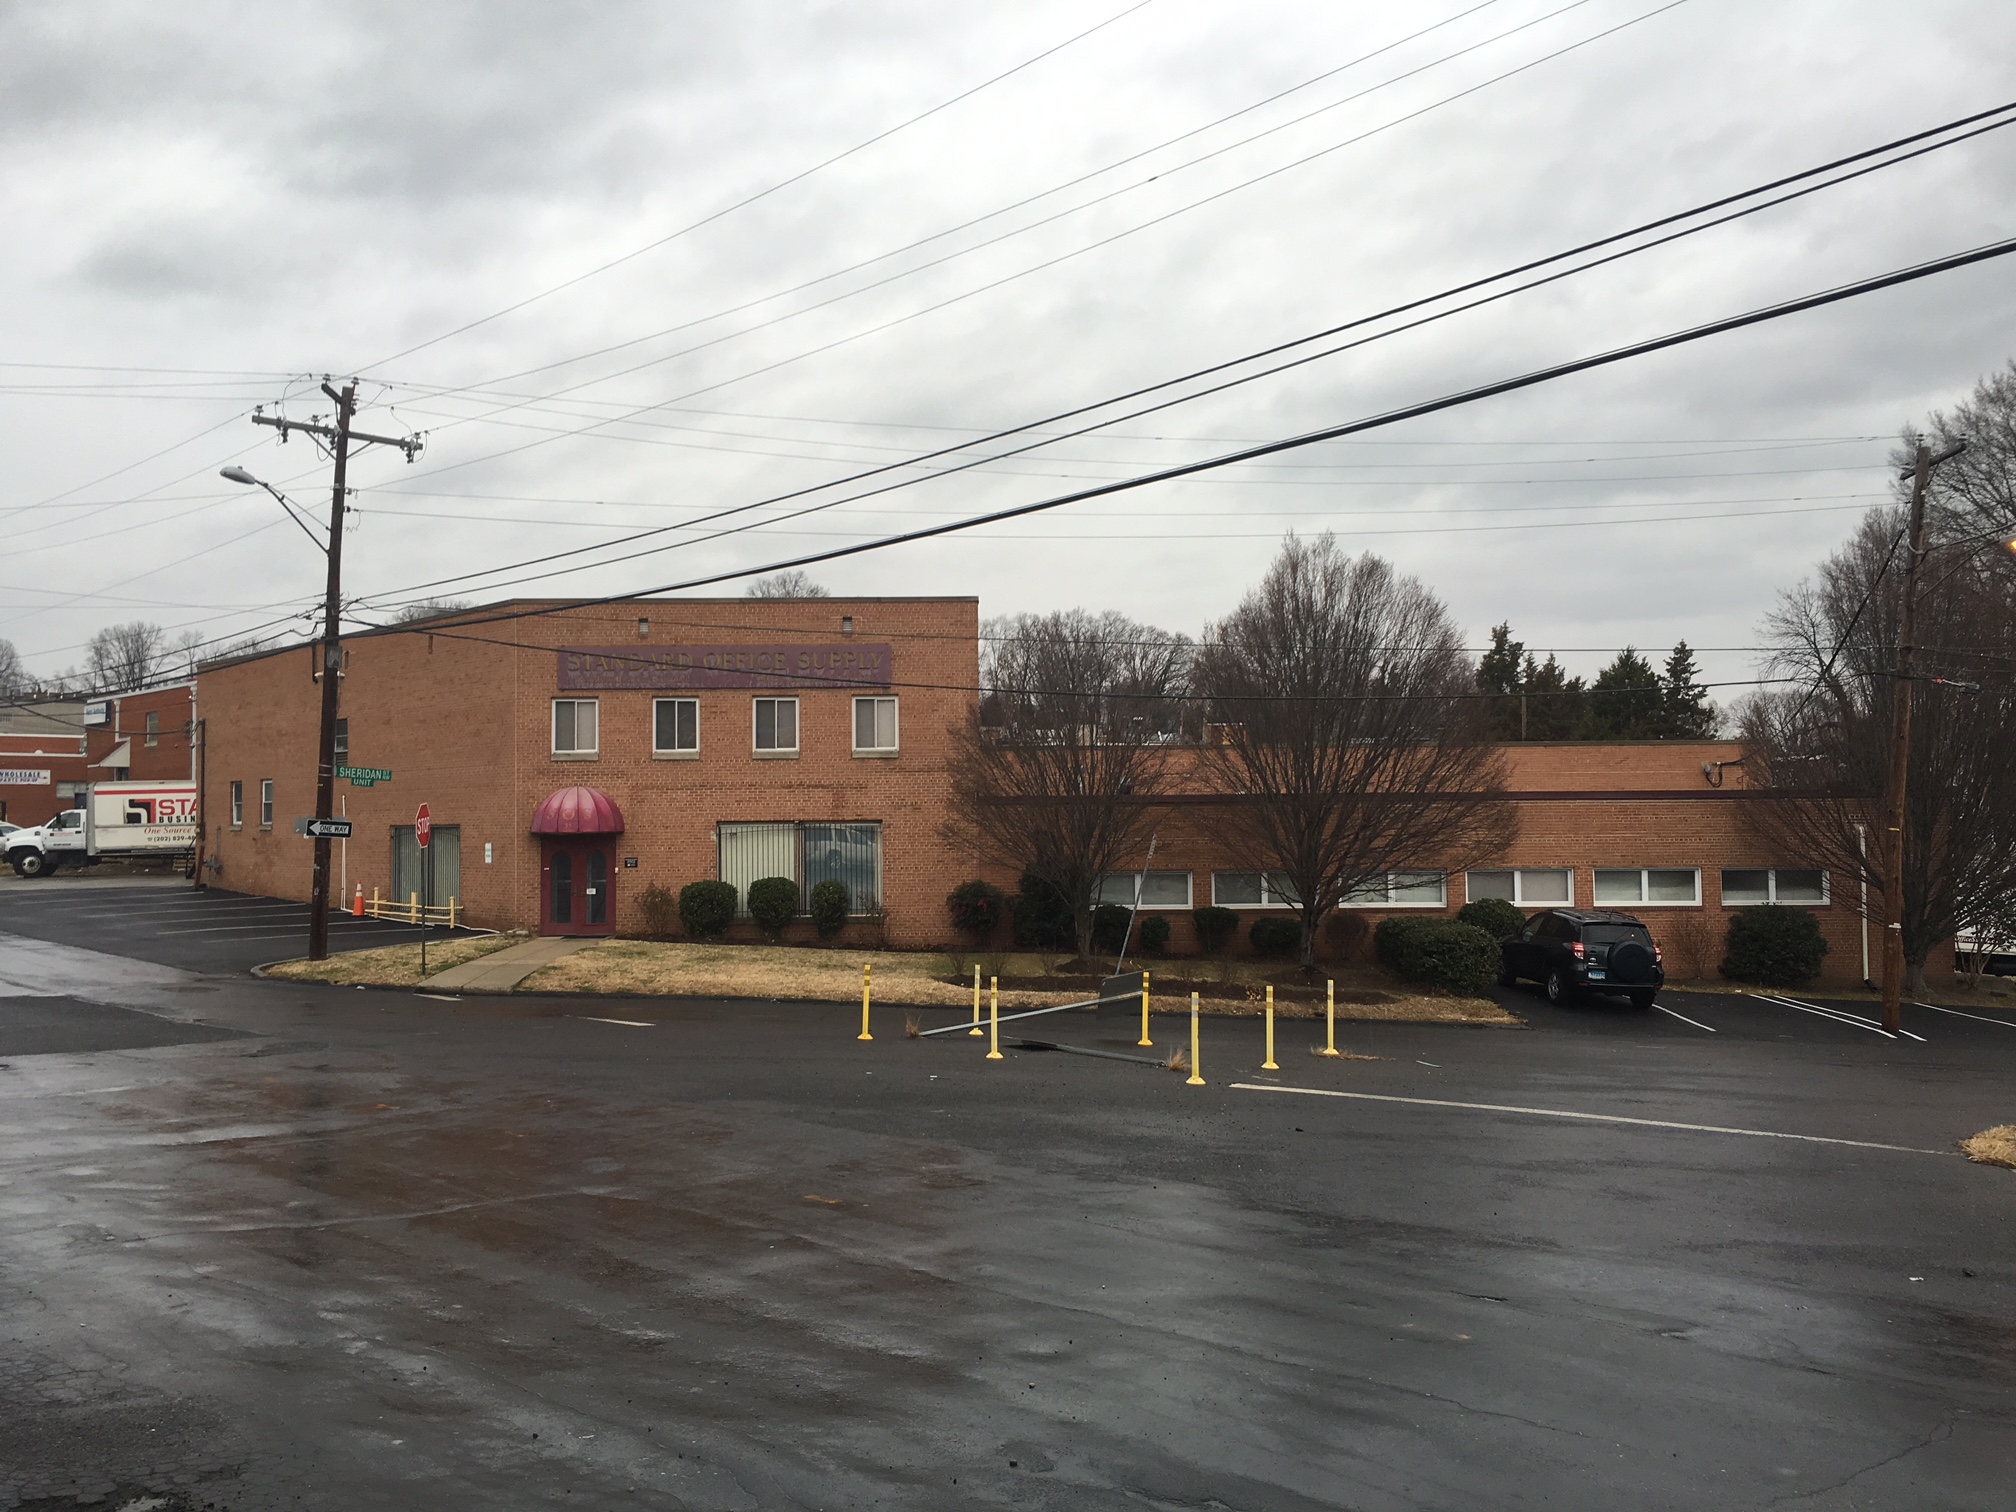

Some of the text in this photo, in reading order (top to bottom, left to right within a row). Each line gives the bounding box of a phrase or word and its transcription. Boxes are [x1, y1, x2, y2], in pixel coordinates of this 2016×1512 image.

[567, 651, 883, 672] STANDARD OFFICE SUPPLY
[339, 767, 382, 780] SHERIDAN
[144, 826, 192, 835] One Source
[320, 824, 348, 833] ONE WAY
[417, 817, 430, 835] STOP
